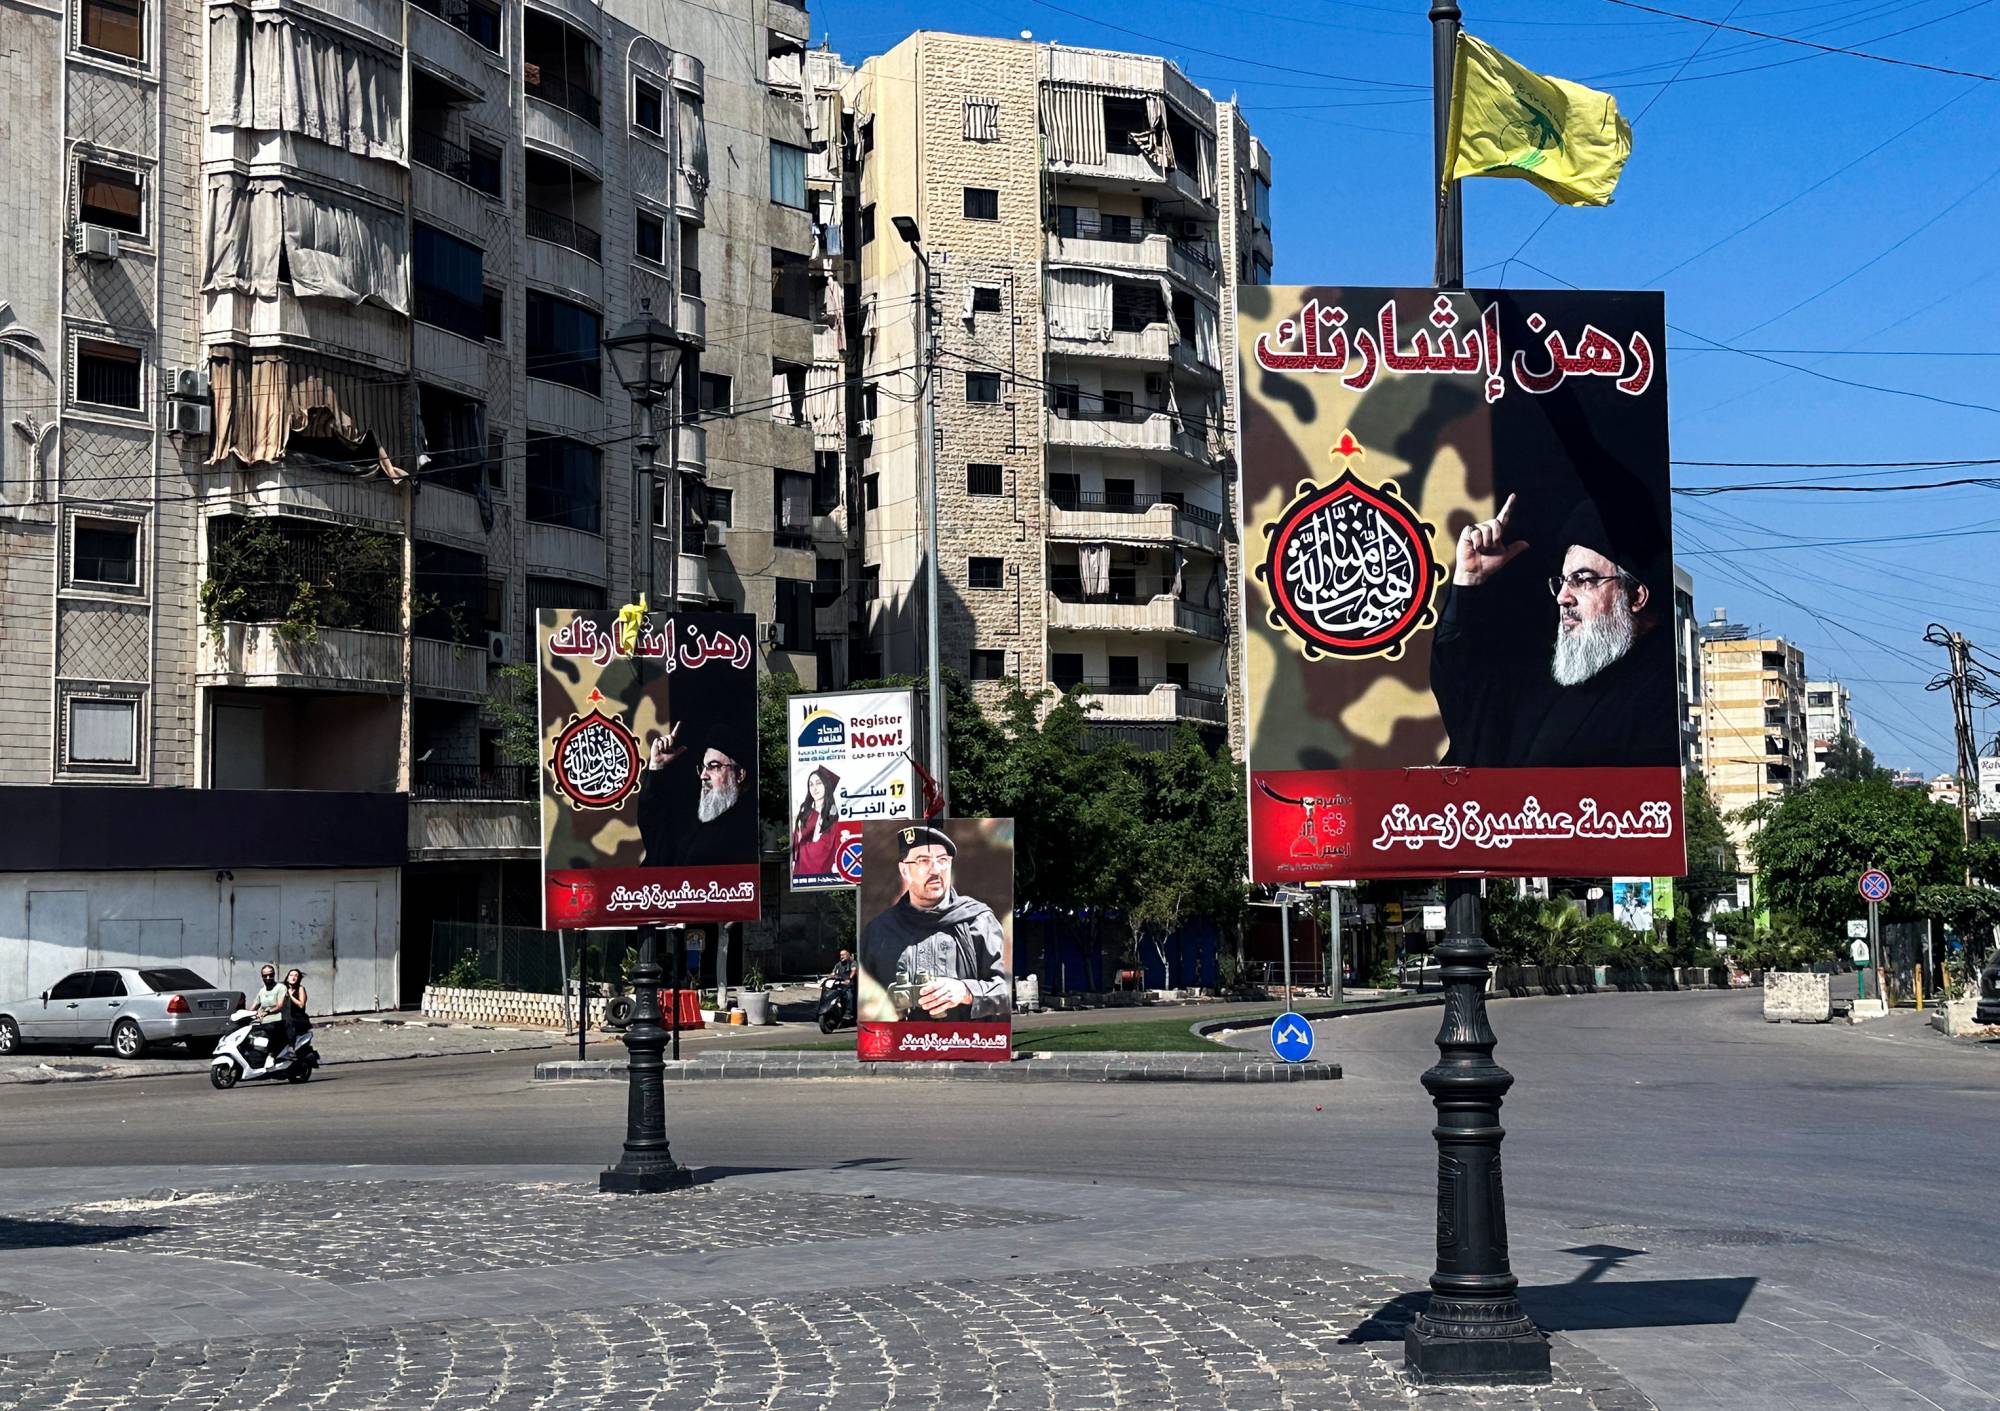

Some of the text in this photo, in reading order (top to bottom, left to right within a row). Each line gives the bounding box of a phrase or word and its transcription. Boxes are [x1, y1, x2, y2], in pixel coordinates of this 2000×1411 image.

[1254, 295, 1654, 404] رهن إشارتك
[680, 624, 751, 669] رهن
[851, 729, 903, 748] Now!
[890, 783, 905, 796] 17
[840, 801, 906, 818] من الخبرة
[1372, 795, 1672, 850] تقدمة عشيرة زعيتر
[606, 880, 754, 911] تقدمة عشيرة زعيتر
